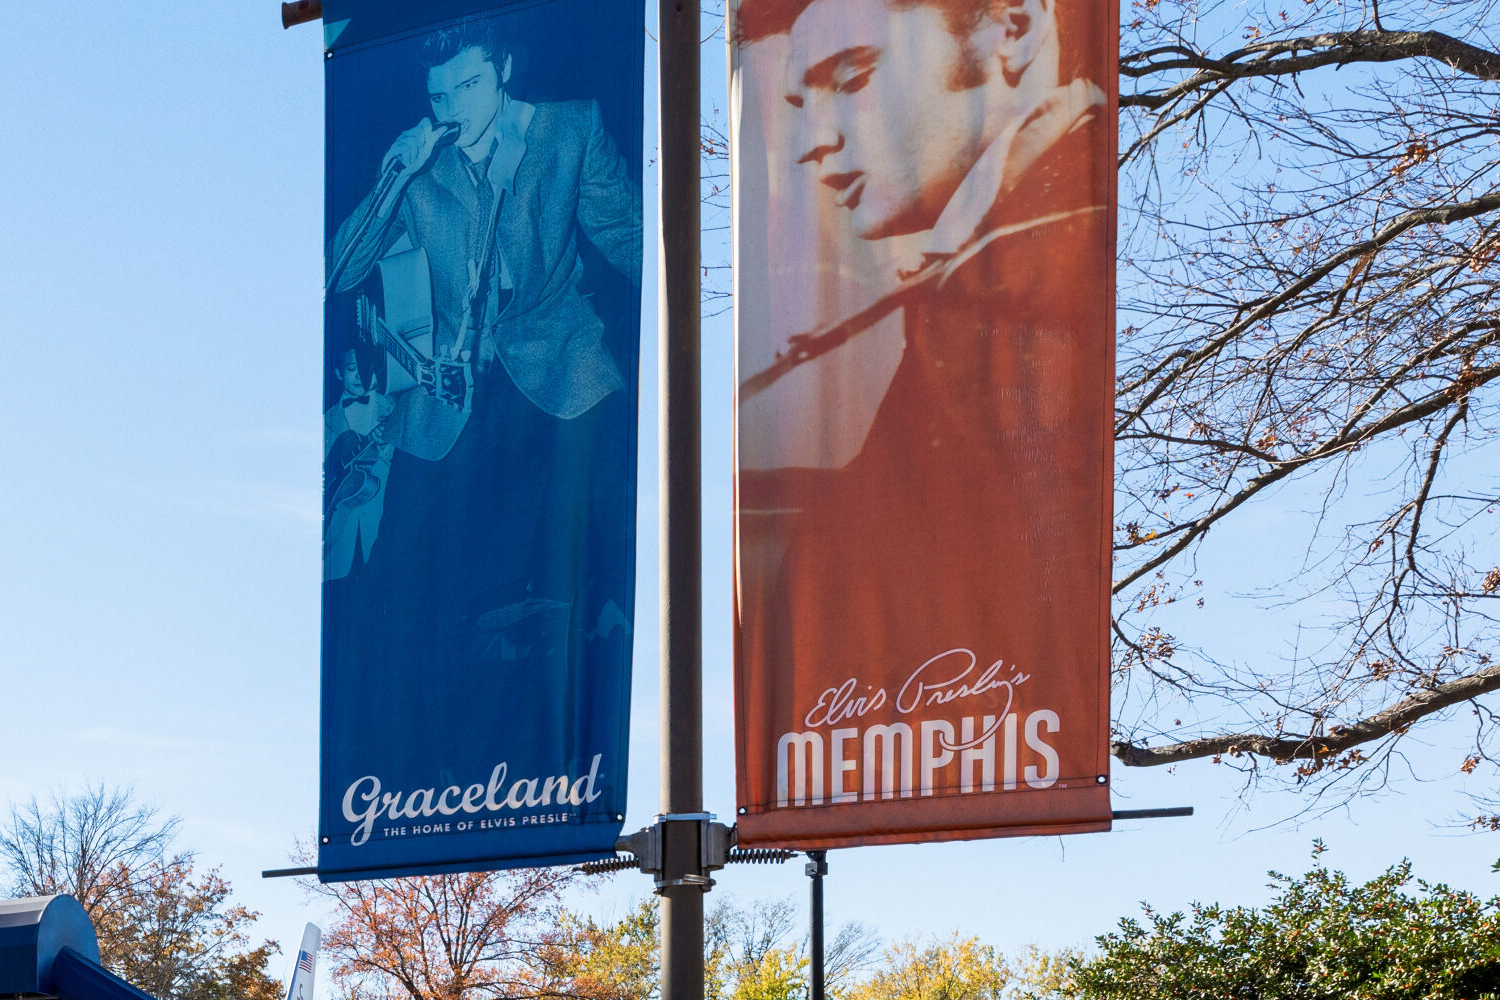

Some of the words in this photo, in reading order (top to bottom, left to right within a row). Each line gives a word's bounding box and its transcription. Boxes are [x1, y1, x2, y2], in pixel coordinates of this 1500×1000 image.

[804, 678, 887, 728] Elvis
[777, 709, 1061, 808] MEMPHIS
[342, 753, 602, 847] Graceland
[383, 827, 407, 837] THE
[412, 824, 451, 835] HOME
[457, 821, 474, 831] OF
[480, 817, 516, 829] ELVIS
